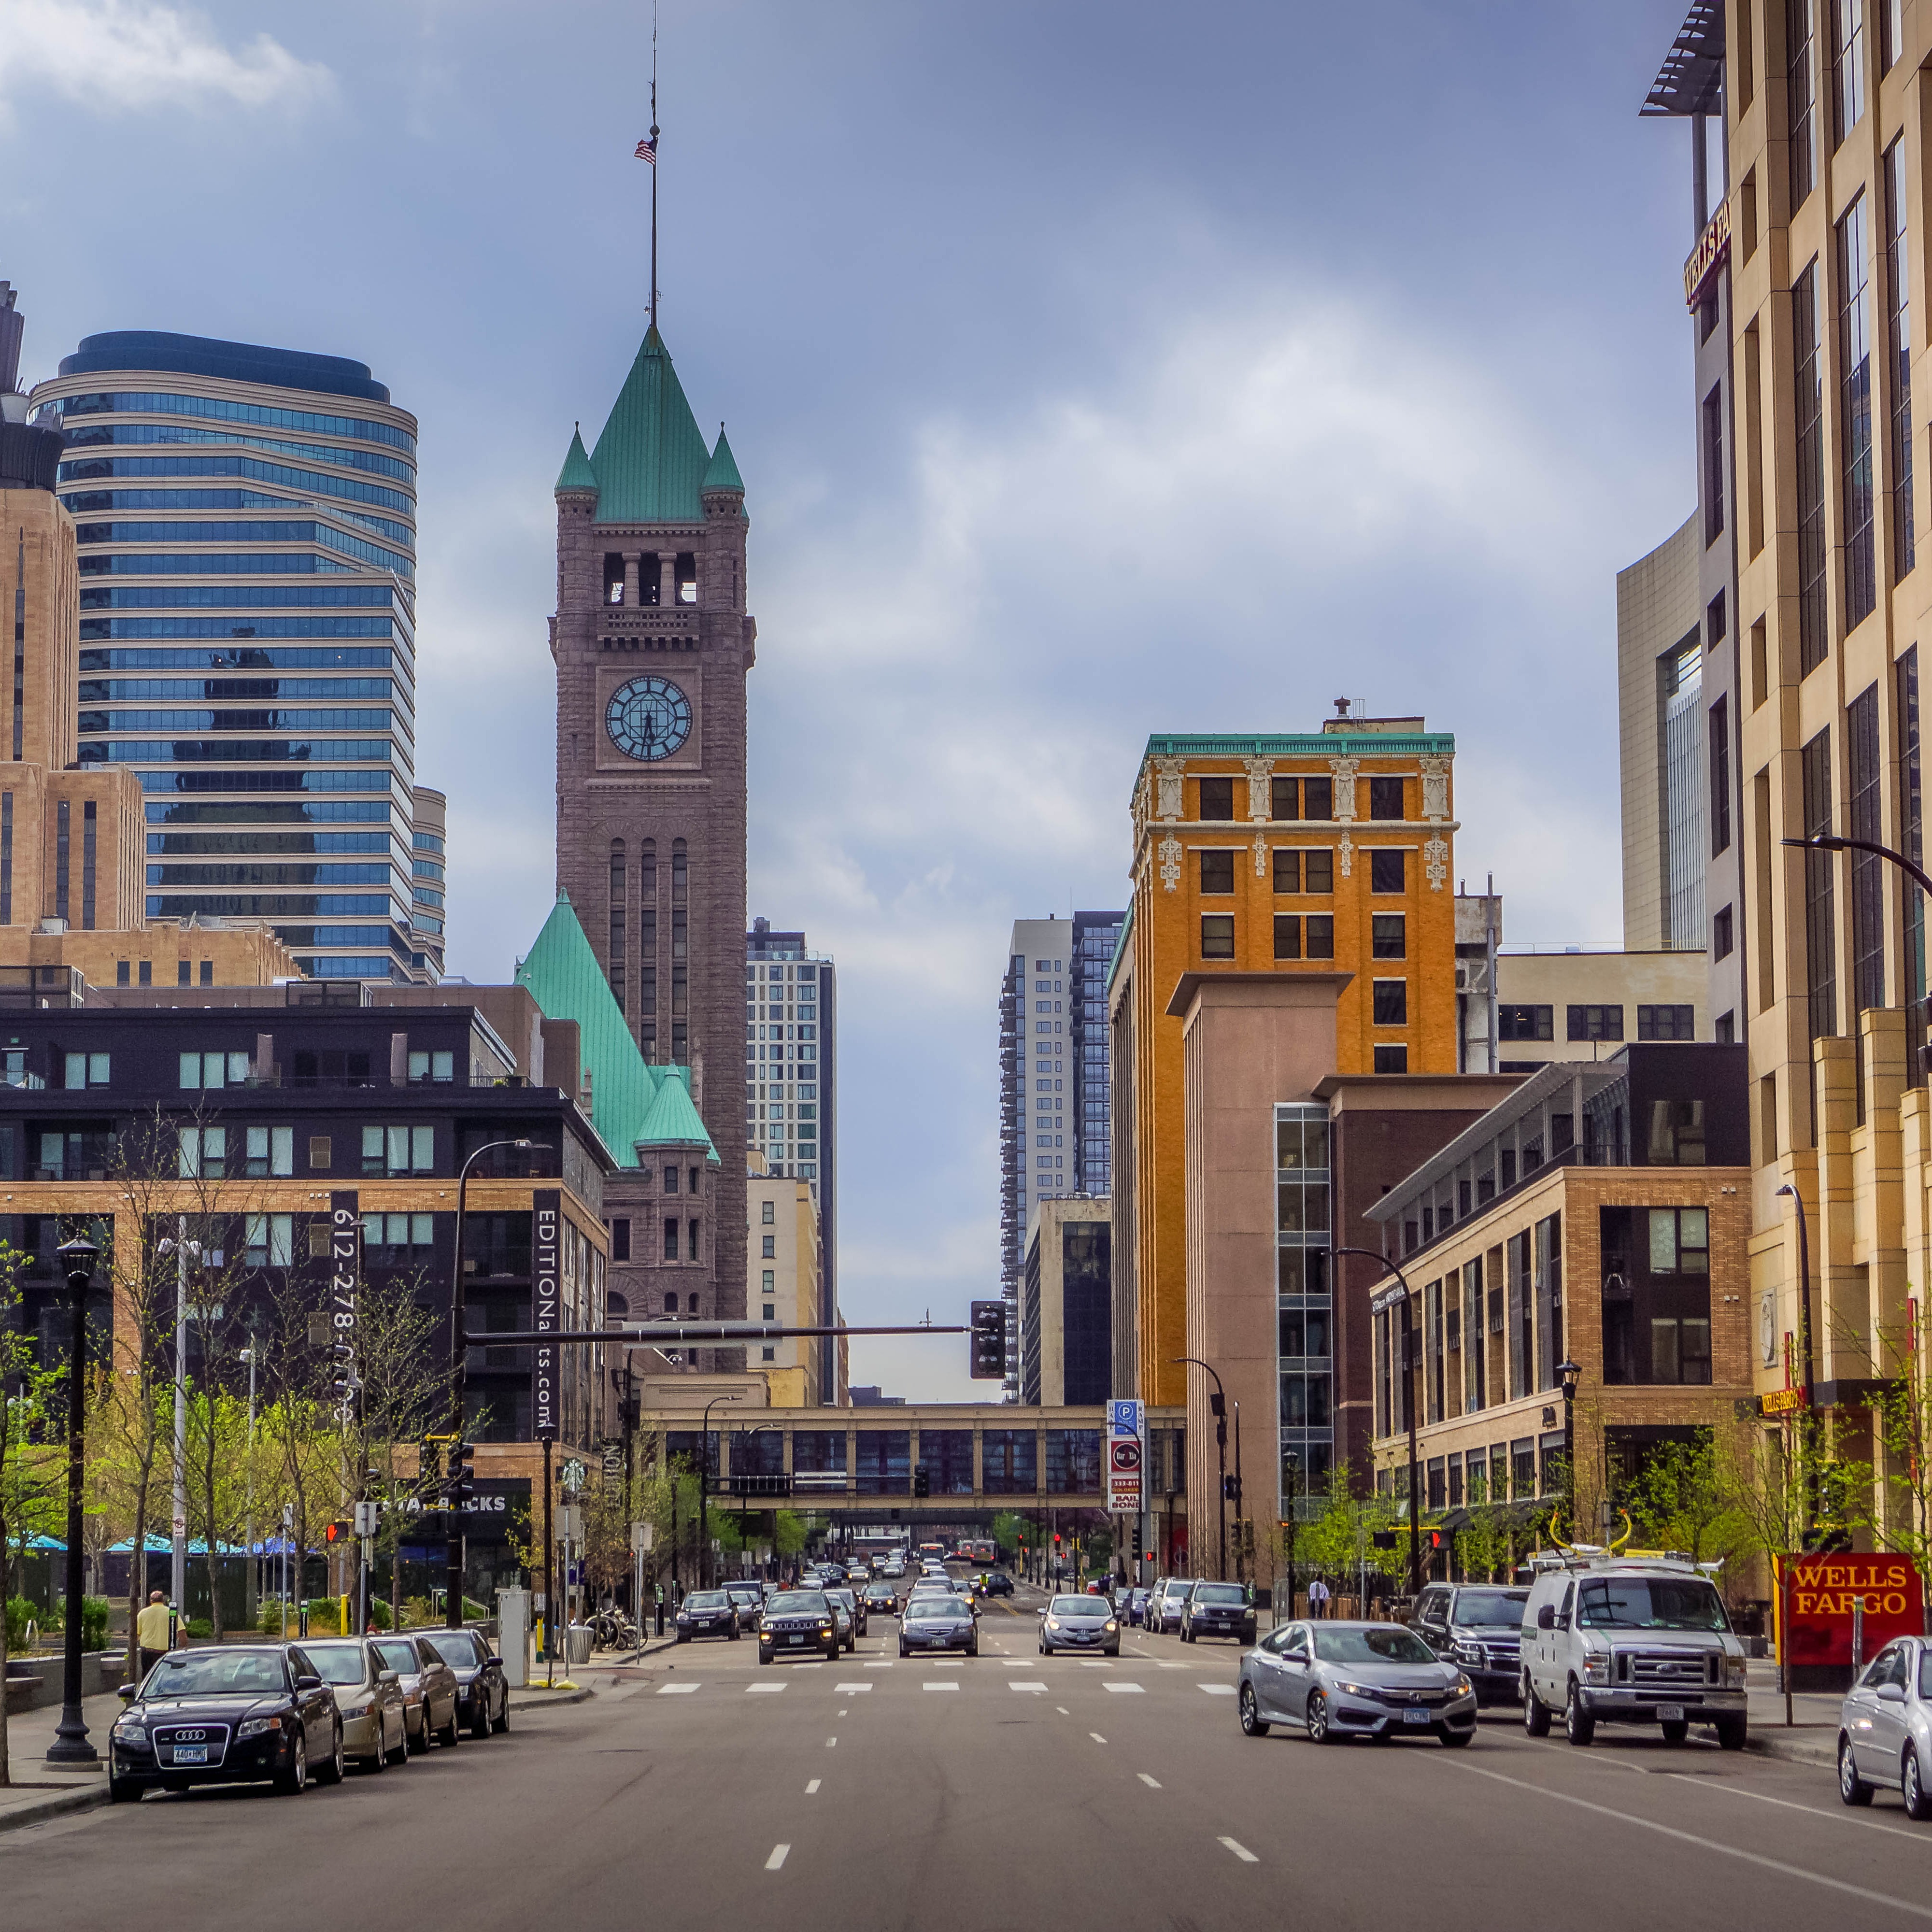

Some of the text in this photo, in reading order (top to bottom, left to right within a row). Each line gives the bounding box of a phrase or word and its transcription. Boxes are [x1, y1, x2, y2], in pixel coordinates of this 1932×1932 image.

[1683, 195, 1732, 305] WELLS FA
[539, 1210, 555, 1427] EDITIONats.com
[1122, 1406, 1131, 1417] P
[382, 1497, 505, 1512] STABCKS
[1794, 1565, 1907, 1588] WELLS
[1795, 1592, 1906, 1615] FARGO
